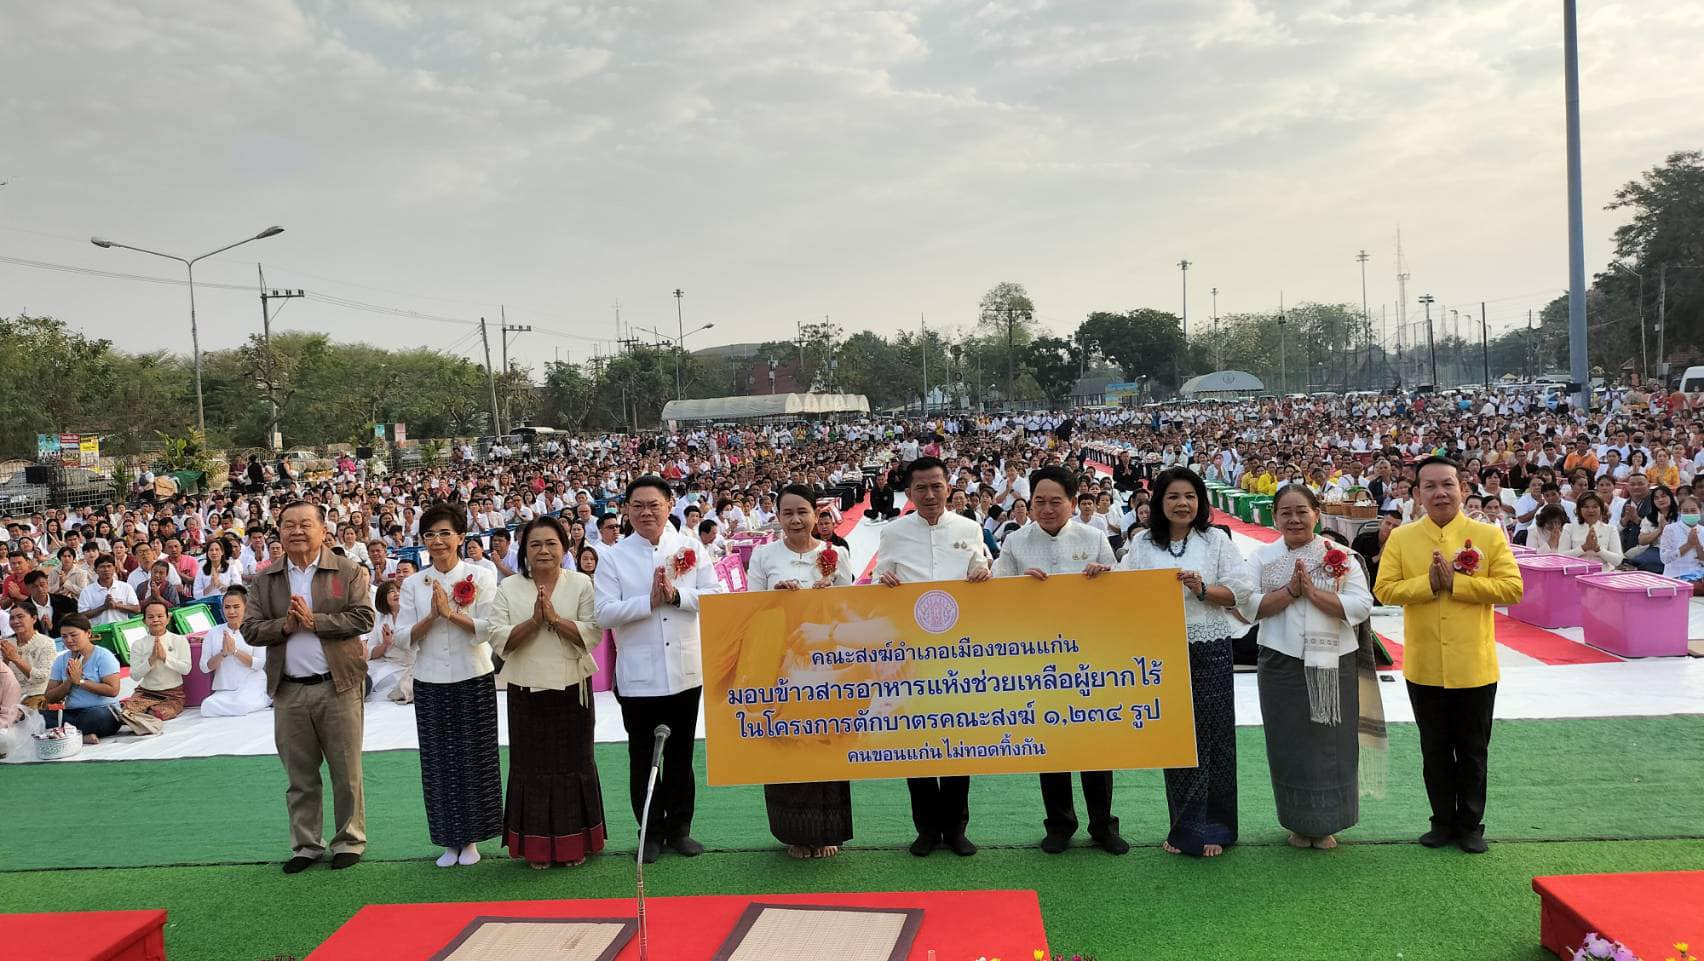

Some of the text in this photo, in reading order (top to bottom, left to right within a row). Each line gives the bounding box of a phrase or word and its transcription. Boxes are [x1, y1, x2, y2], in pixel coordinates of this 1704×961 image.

[811, 634, 1079, 666] คณะสงฆ์อำเภอเมืองขอนแก่น
[727, 656, 1163, 706] มอบข้าวสารอาหารแห้งช่วยเหลือผู้ยากไร้
[735, 698, 1161, 739] ในโครงการตักบาตรคณะสงฆ์ ๑,๒๓๔ รูป
